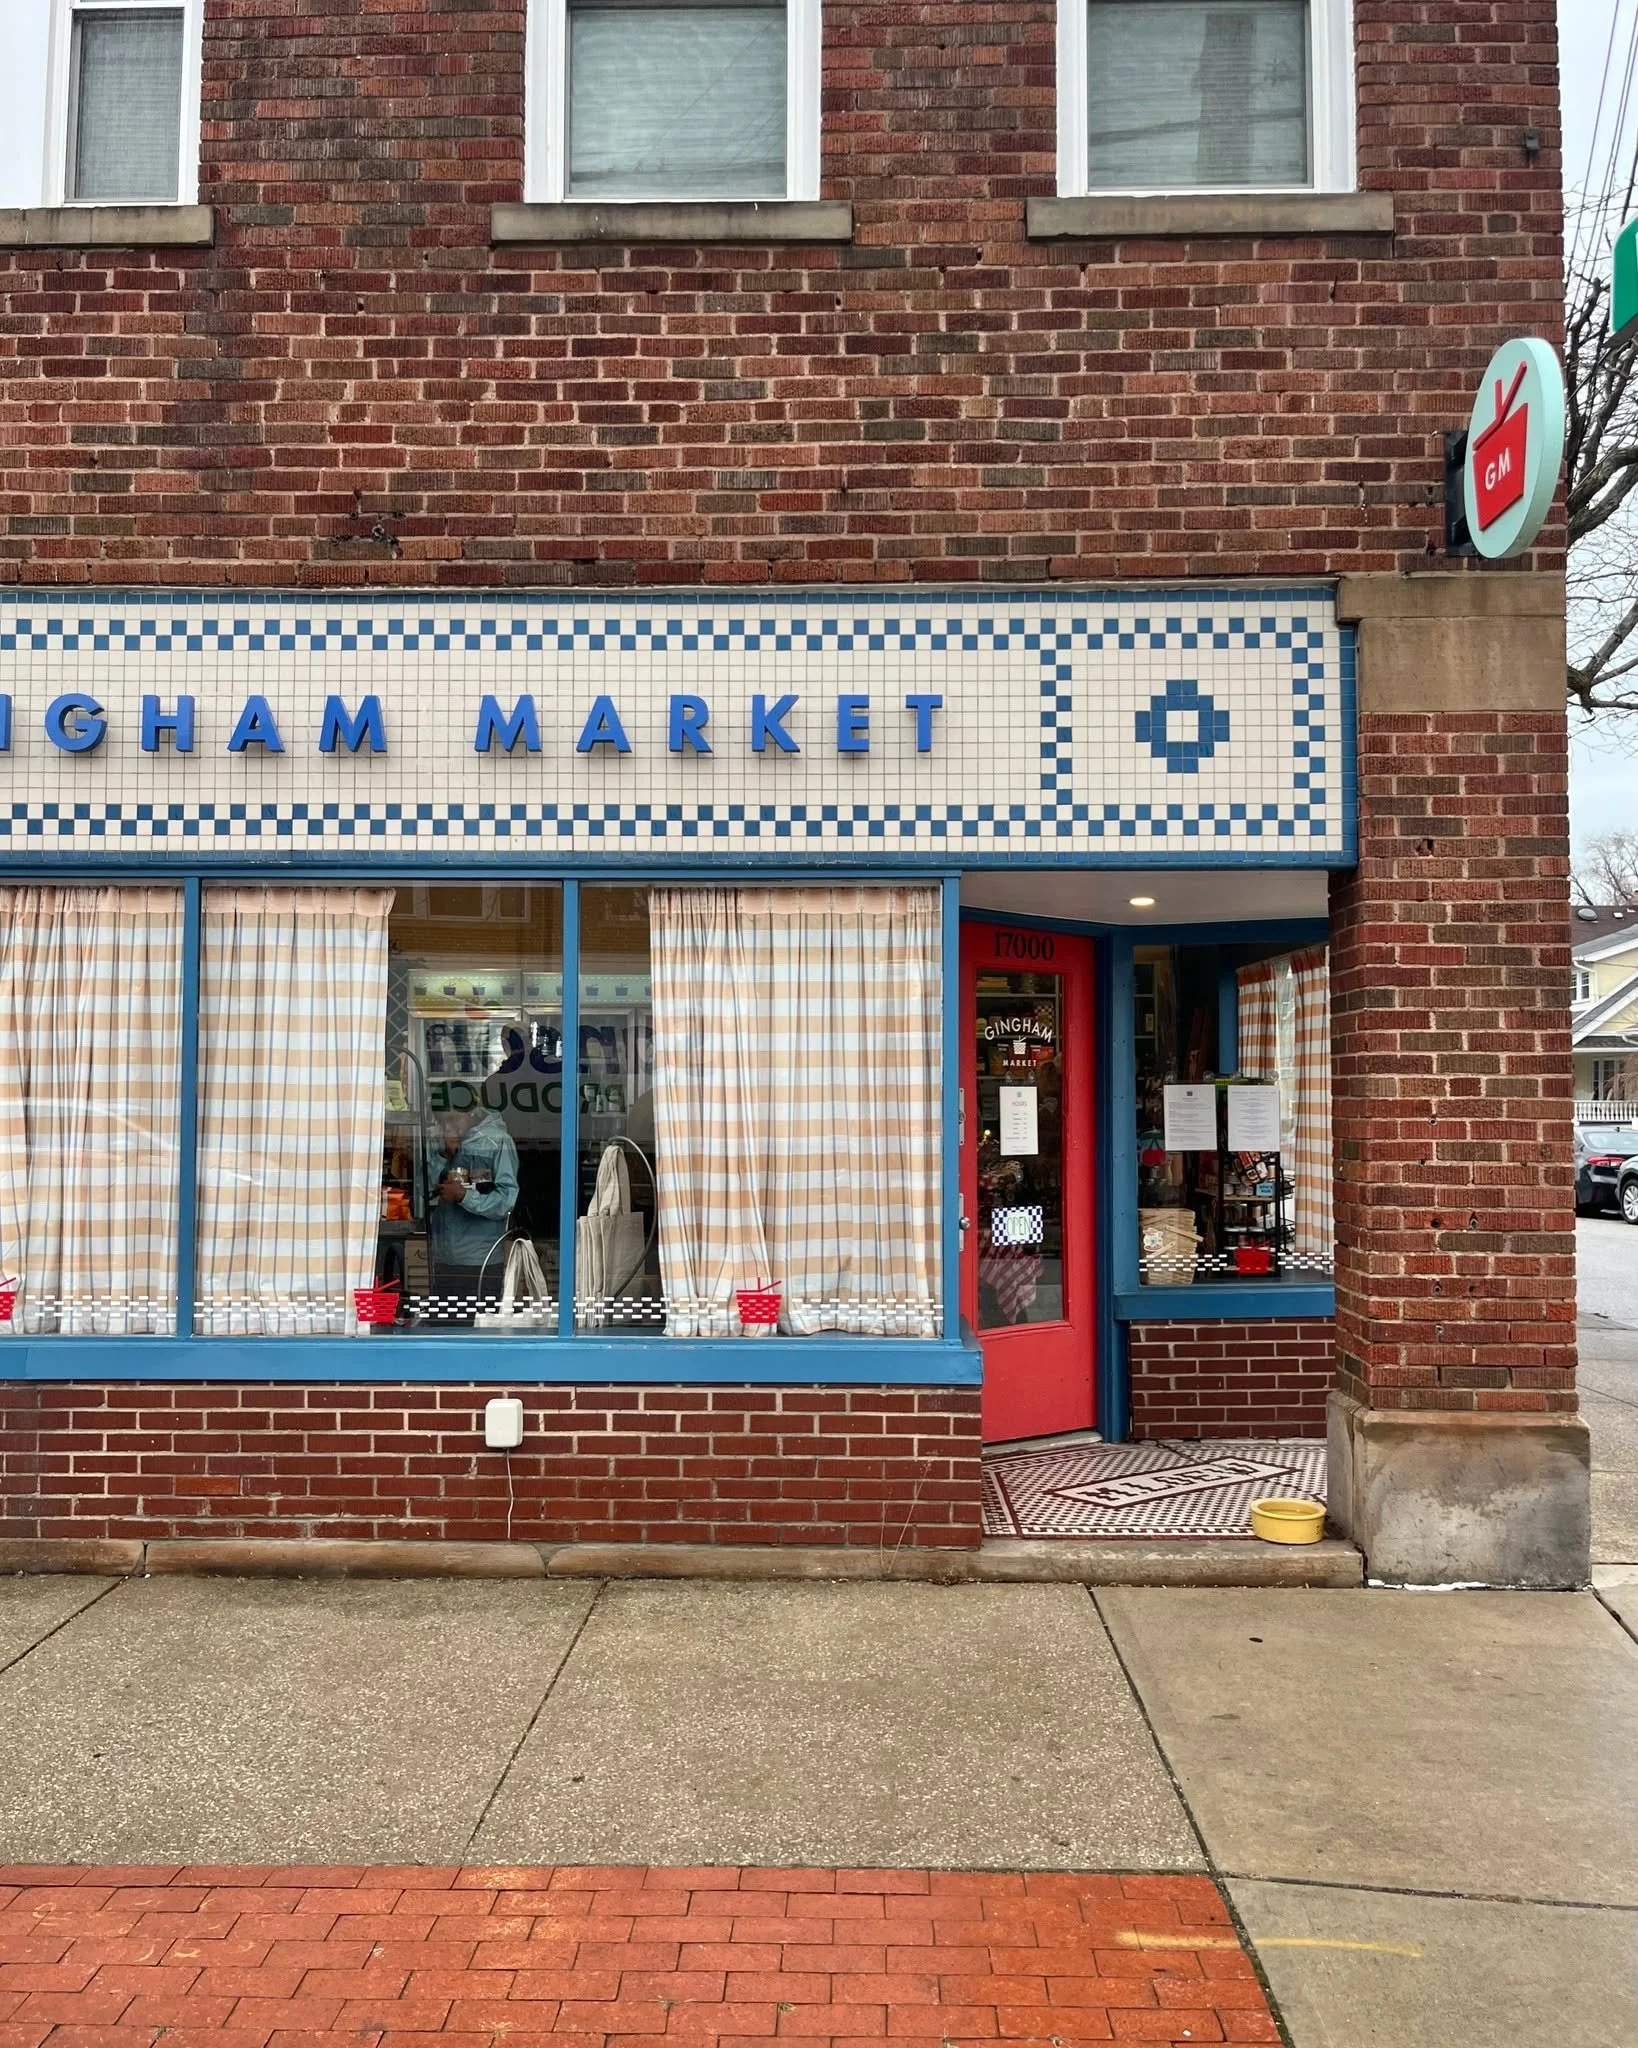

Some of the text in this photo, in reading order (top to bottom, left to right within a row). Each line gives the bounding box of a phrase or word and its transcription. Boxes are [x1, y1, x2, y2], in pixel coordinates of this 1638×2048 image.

[1485, 447, 1510, 491] GM
[0, 693, 943, 753] GHAM MARKET
[994, 932, 1054, 960] 17000
[984, 1018, 1053, 1043] GINGHAM
[1002, 1059, 1037, 1067] MARKET
[1007, 1216, 1031, 1235] OPEN
